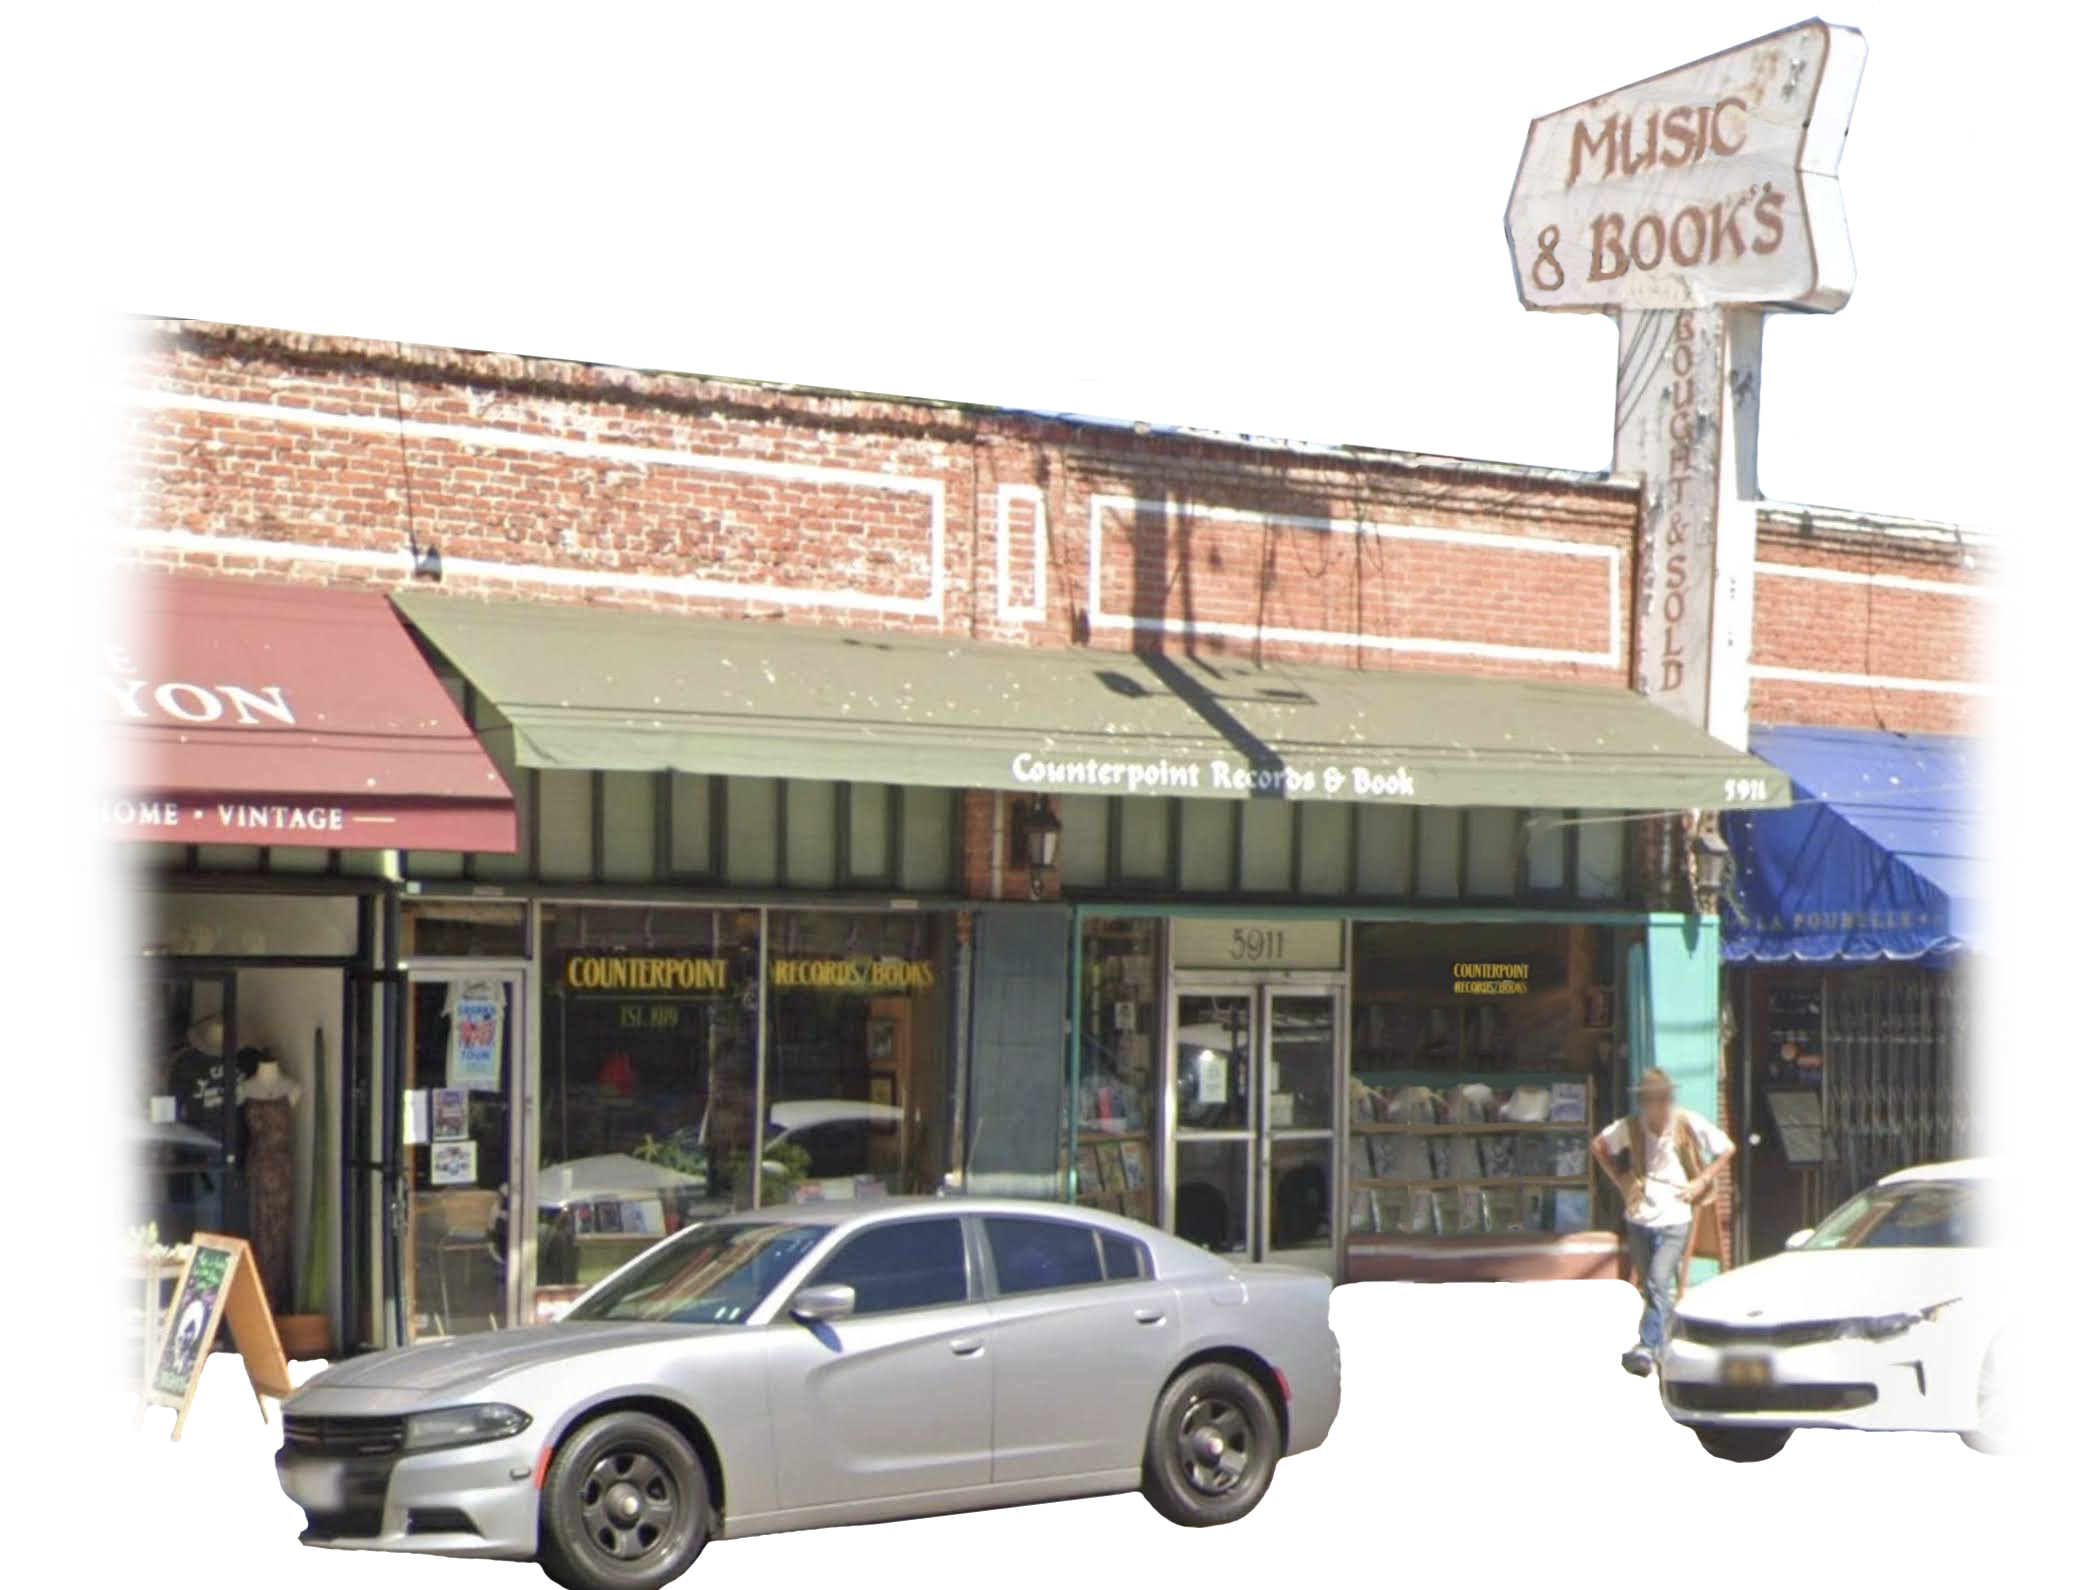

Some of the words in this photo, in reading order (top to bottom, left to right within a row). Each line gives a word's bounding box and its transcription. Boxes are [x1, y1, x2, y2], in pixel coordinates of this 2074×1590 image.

[1566, 97, 1748, 187] MUSIC
[1669, 309, 1695, 505] BOUGHT
[1667, 511, 1691, 545] &
[1661, 555, 1687, 691] SOLD
[1012, 752, 1200, 792] Counterpoint
[1210, 760, 1315, 793] Records
[1323, 766, 1346, 794] &
[1352, 766, 1415, 796] Book
[1724, 778, 1767, 802] 5911
[90, 800, 179, 826] HOME
[218, 804, 344, 831] VINTAGE
[1227, 928, 1285, 961] 5911
[567, 956, 729, 989] COUNTERPOINT
[1453, 963, 1530, 979] COUNTERPOINT
